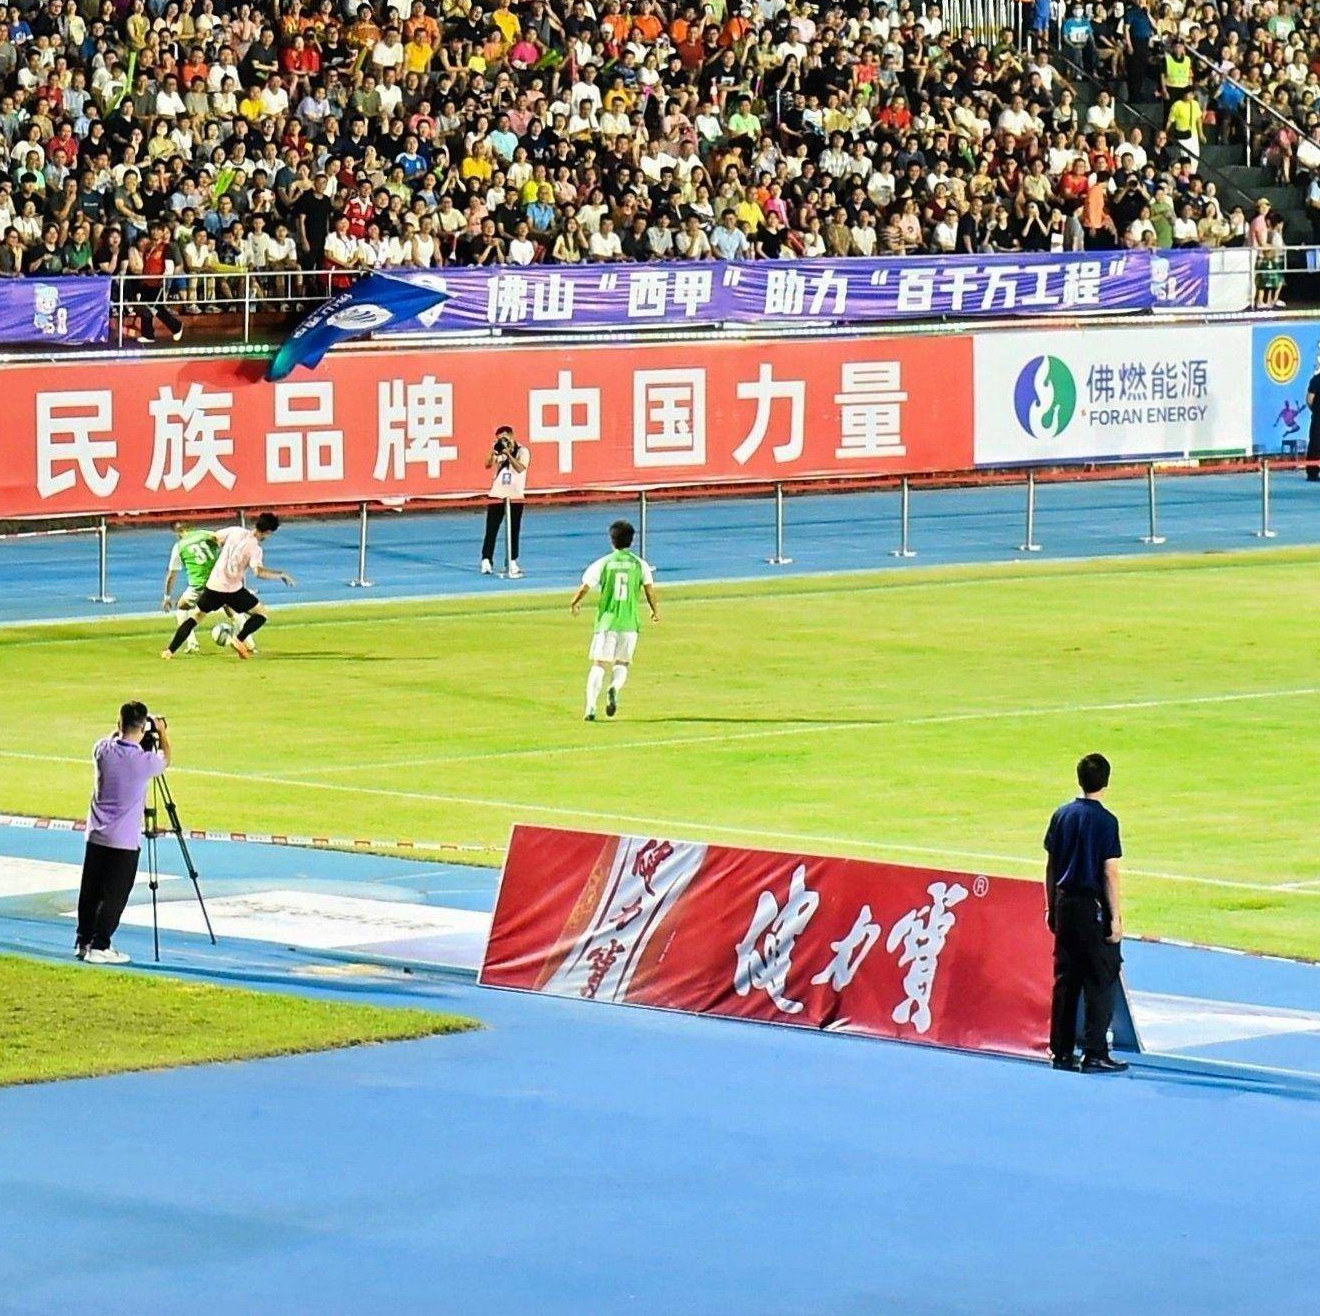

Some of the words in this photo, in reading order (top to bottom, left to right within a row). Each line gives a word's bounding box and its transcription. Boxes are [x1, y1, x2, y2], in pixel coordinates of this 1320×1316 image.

[1086, 360, 1209, 403] 佛燃能源
[35, 376, 457, 498] 民族品牌
[527, 361, 909, 474] 中国力量
[1089, 407, 1142, 427] FORAN
[1147, 405, 1209, 424] ENERGY
